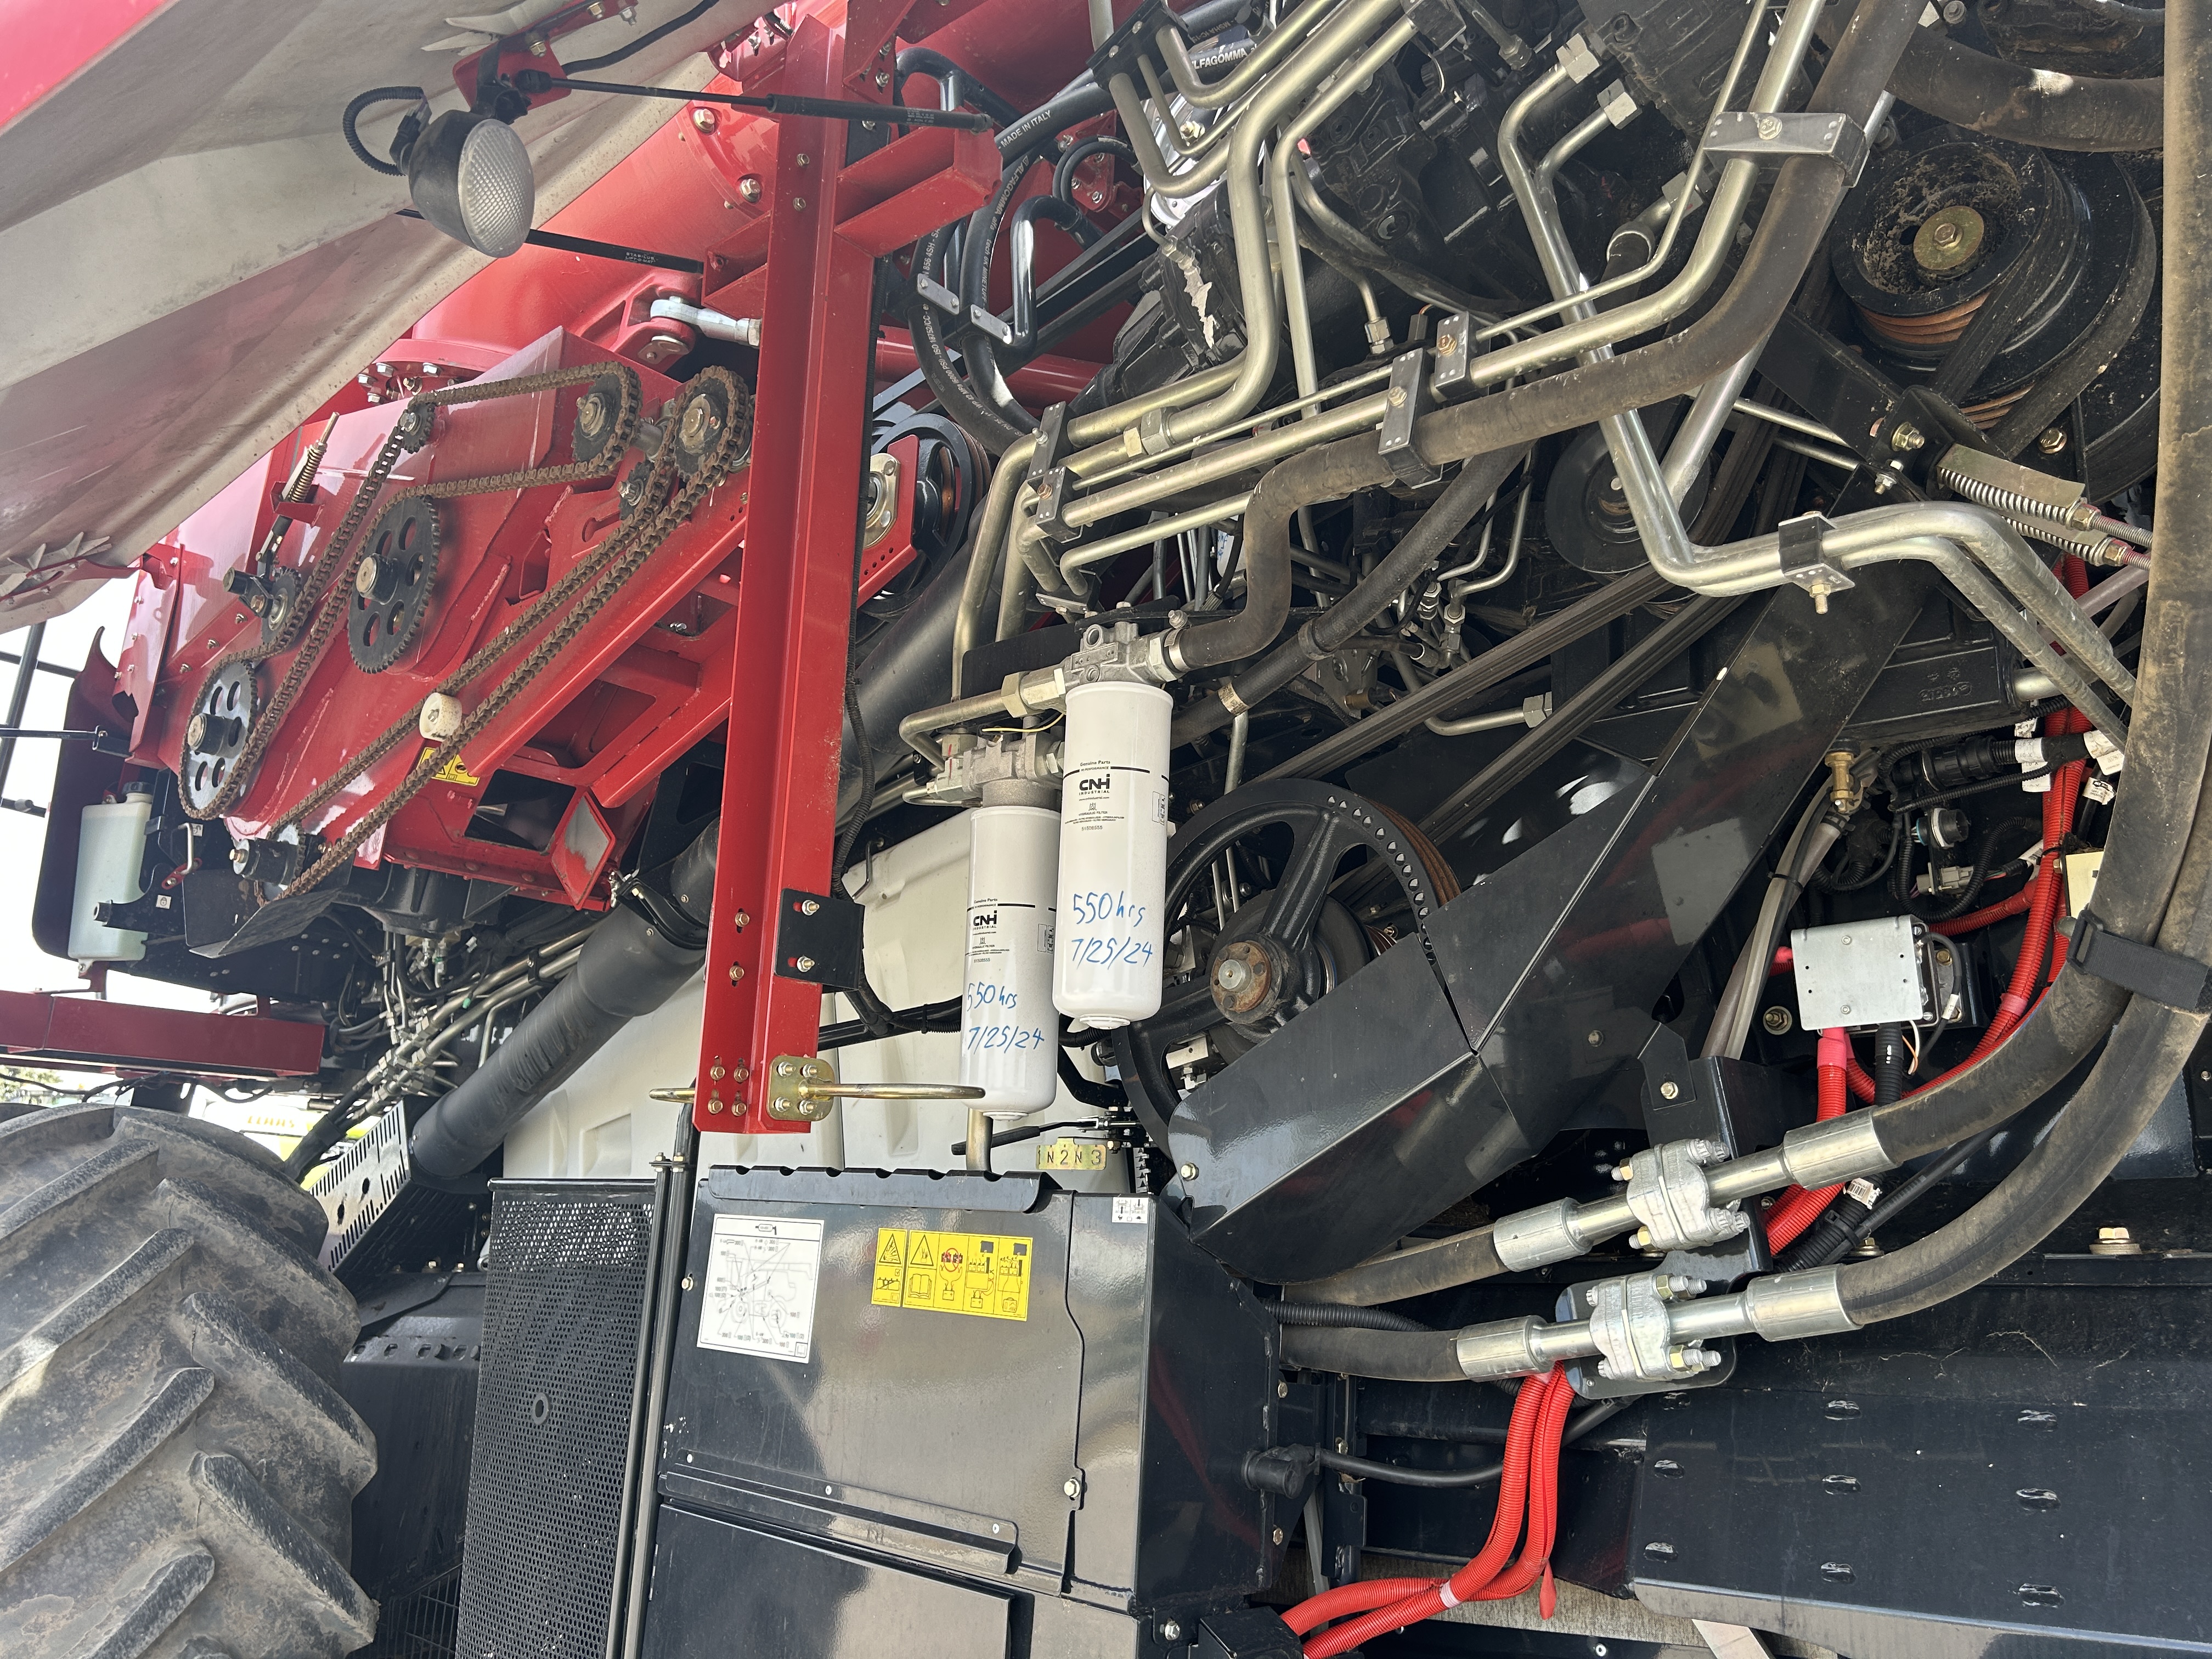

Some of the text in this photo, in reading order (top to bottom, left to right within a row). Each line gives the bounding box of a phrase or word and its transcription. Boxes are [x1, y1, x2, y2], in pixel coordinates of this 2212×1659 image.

[1209, 21, 1231, 33] MSHA
[1192, 48, 1248, 70] LFAGOMMA
[1000, 110, 1051, 148] MADE IN ITALY
[995, 162, 1024, 215] ALFAGOMMA
[923, 257, 932, 270] 856
[926, 242, 935, 257] 4SH
[923, 315, 936, 343] 18752/CC
[931, 344, 942, 356] ISO
[1073, 890, 1146, 928] 550 hrs
[1071, 936, 1153, 970] 7/25/24
[967, 981, 1018, 1012] 550 hrs
[967, 1025, 1045, 1055] 7/25/24
[1047, 1151, 1054, 1163] N
[1060, 1149, 1069, 1165] 2
[1075, 1151, 1082, 1163] N
[1091, 1149, 1102, 1165] 3
